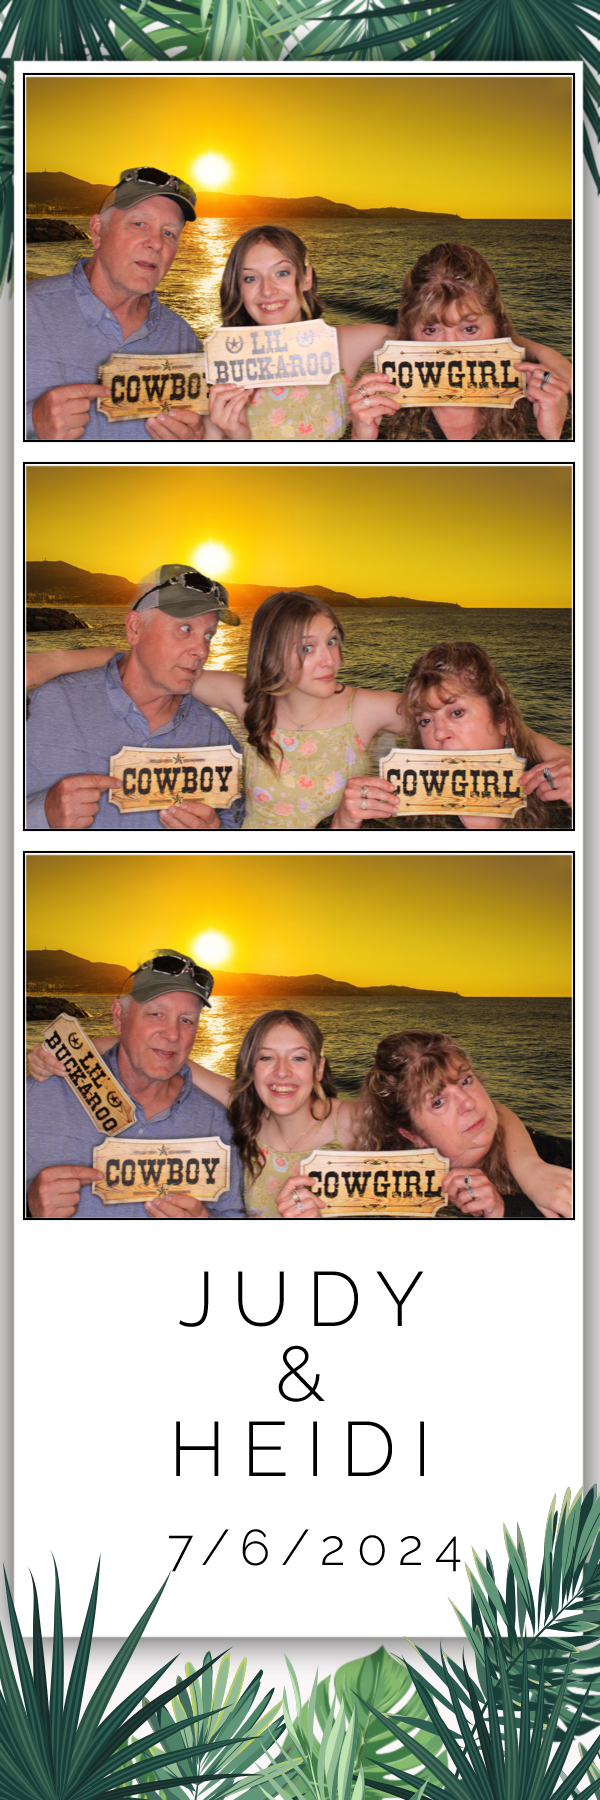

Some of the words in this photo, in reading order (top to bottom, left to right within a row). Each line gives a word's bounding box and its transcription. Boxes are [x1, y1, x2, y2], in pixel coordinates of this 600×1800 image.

[111, 370, 209, 403] COWBO
[382, 360, 520, 389] COWGIRL
[123, 766, 232, 795] COWBOY
[387, 769, 520, 798] COWGIRL
[106, 1158, 220, 1187] COWBOY
[308, 1170, 442, 1198] COWGIRL
